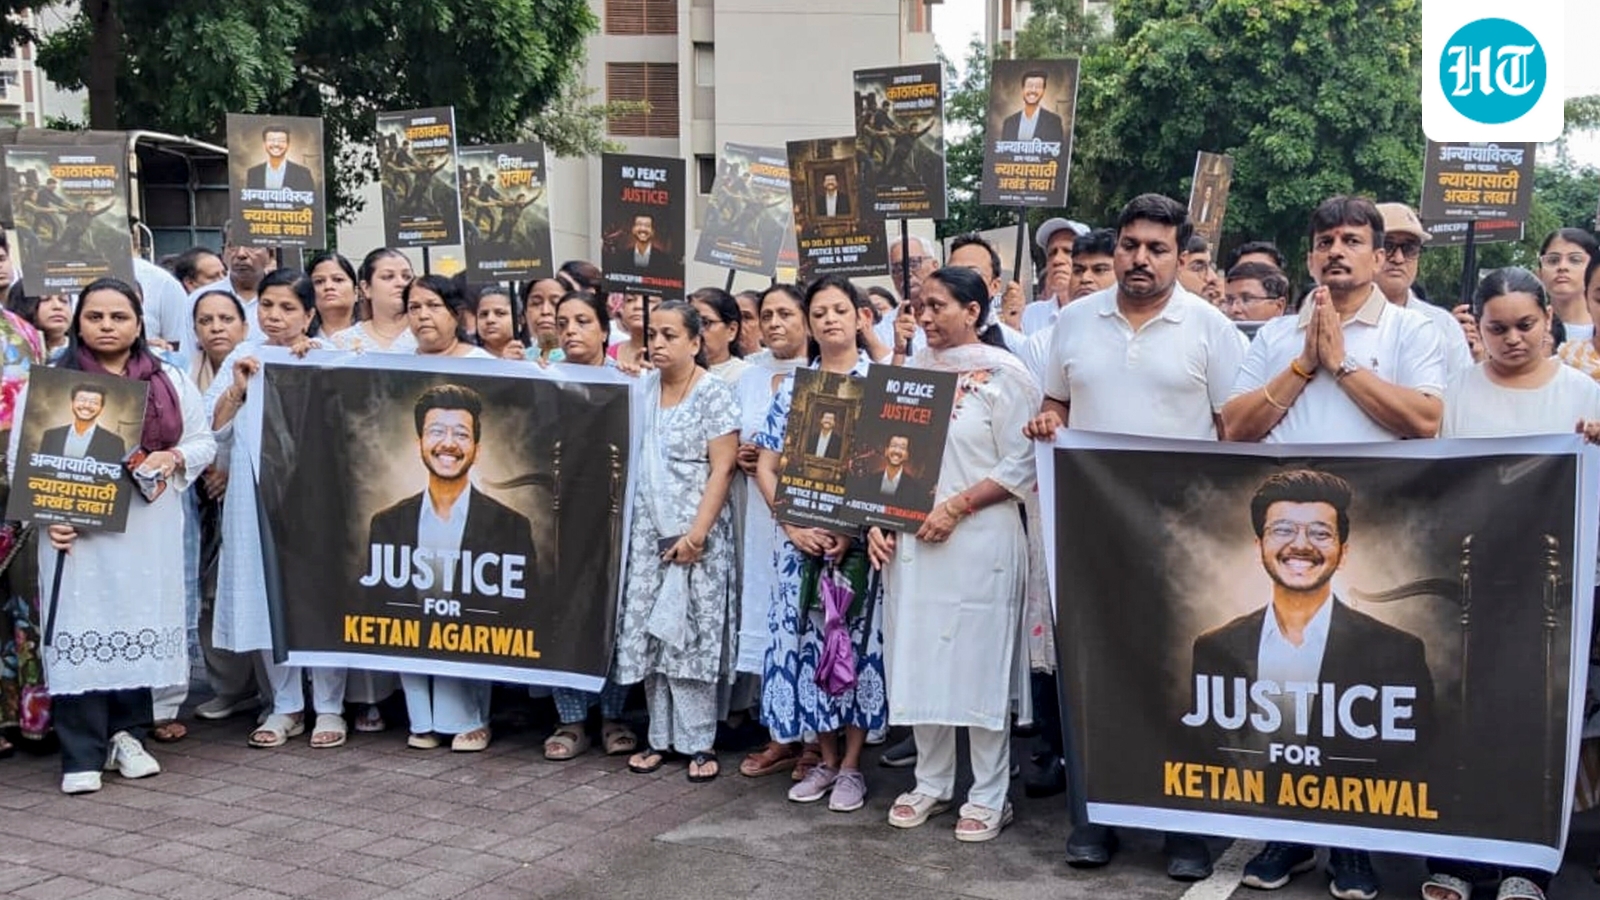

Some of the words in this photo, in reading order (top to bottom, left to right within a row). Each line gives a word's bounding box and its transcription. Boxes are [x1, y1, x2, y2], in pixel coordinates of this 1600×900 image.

[621, 166, 635, 178] NO
[637, 166, 667, 182] PEACE
[994, 160, 1059, 178] न्यायासाठी
[1438, 170, 1520, 189] न्यायासाठी
[621, 187, 669, 205] JUSTICE!
[1443, 187, 1480, 203] अखंड
[242, 207, 313, 224] न्यायासाठी
[886, 379, 900, 393] NO
[902, 382, 935, 399] PEACE
[880, 403, 933, 426] JUSTICE!
[29, 453, 122, 479] अन्यायाविरुद्ध
[28, 477, 118, 501] न्यायासाठी
[32, 494, 74, 510] अखंड
[359, 543, 527, 599] JUSTICE
[424, 598, 461, 617] FOR
[344, 615, 420, 648] KETAN
[428, 622, 541, 658] AGARWAL
[1181, 673, 1417, 742] JUSTICE
[1269, 743, 1322, 767] FOR
[1164, 761, 1265, 804] KETAN
[1277, 773, 1439, 819] AGARWAL
